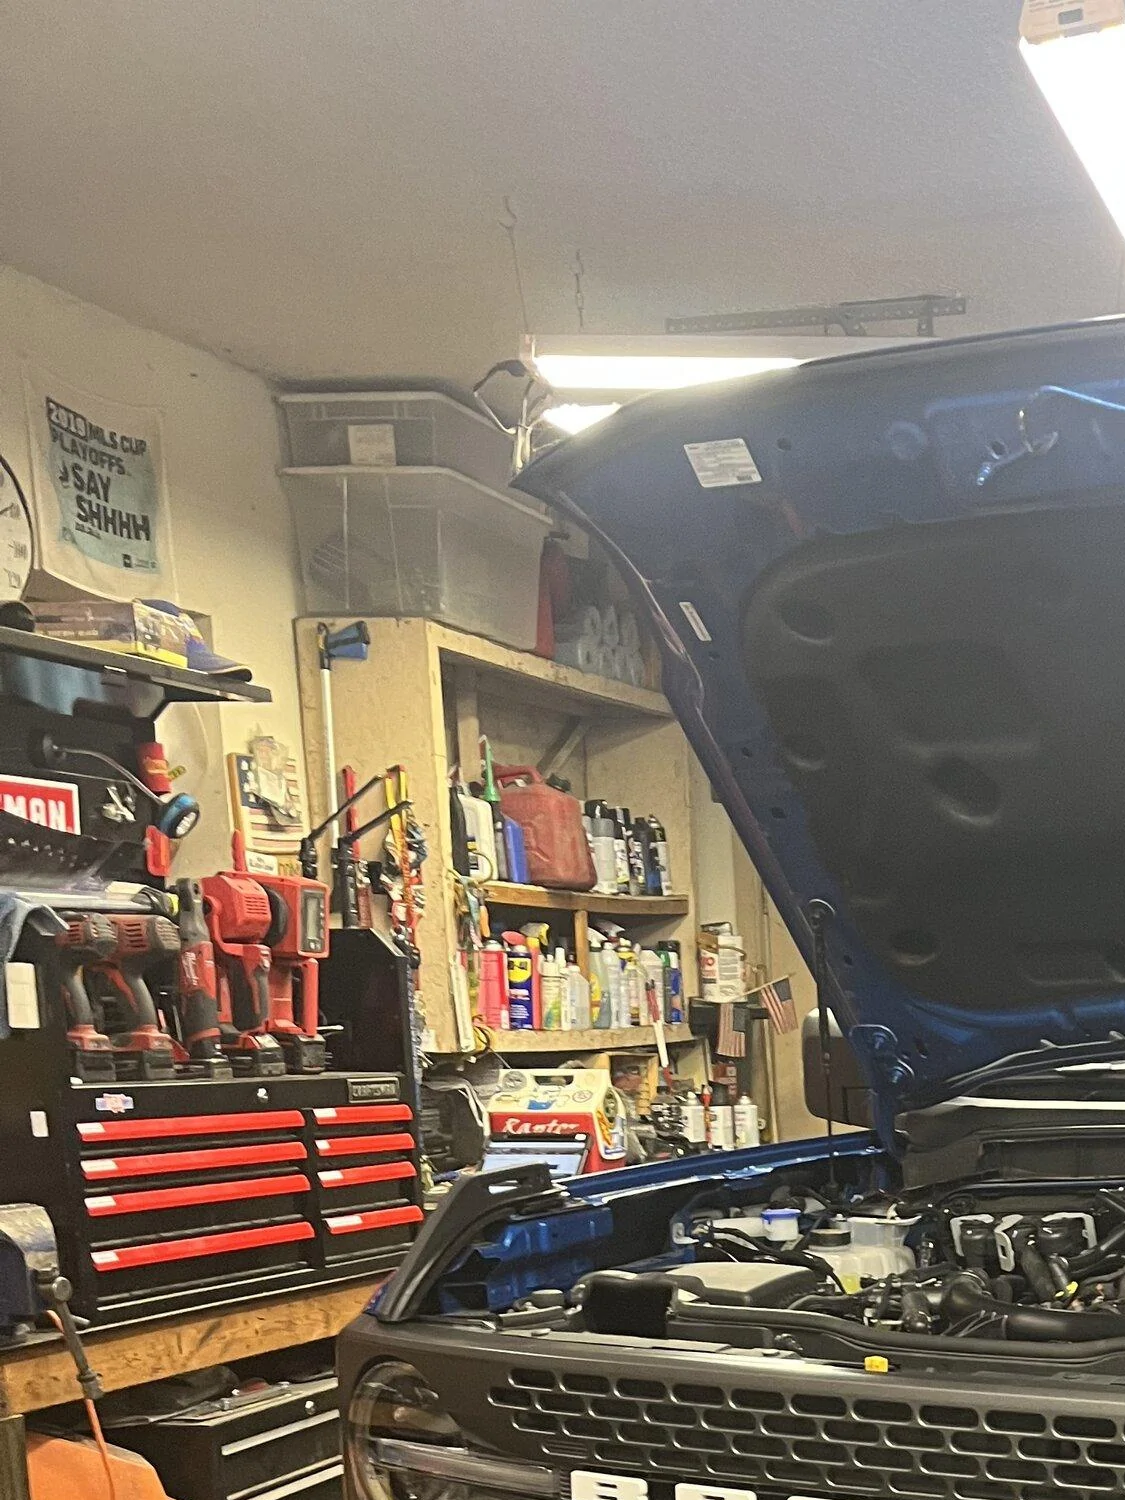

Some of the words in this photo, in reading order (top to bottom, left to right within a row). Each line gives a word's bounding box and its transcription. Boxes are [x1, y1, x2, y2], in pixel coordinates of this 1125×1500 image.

[51, 424, 126, 475] PLAYOFFS
[88, 421, 119, 450] MLS
[119, 434, 147, 456] CUP
[71, 462, 111, 503] SAY
